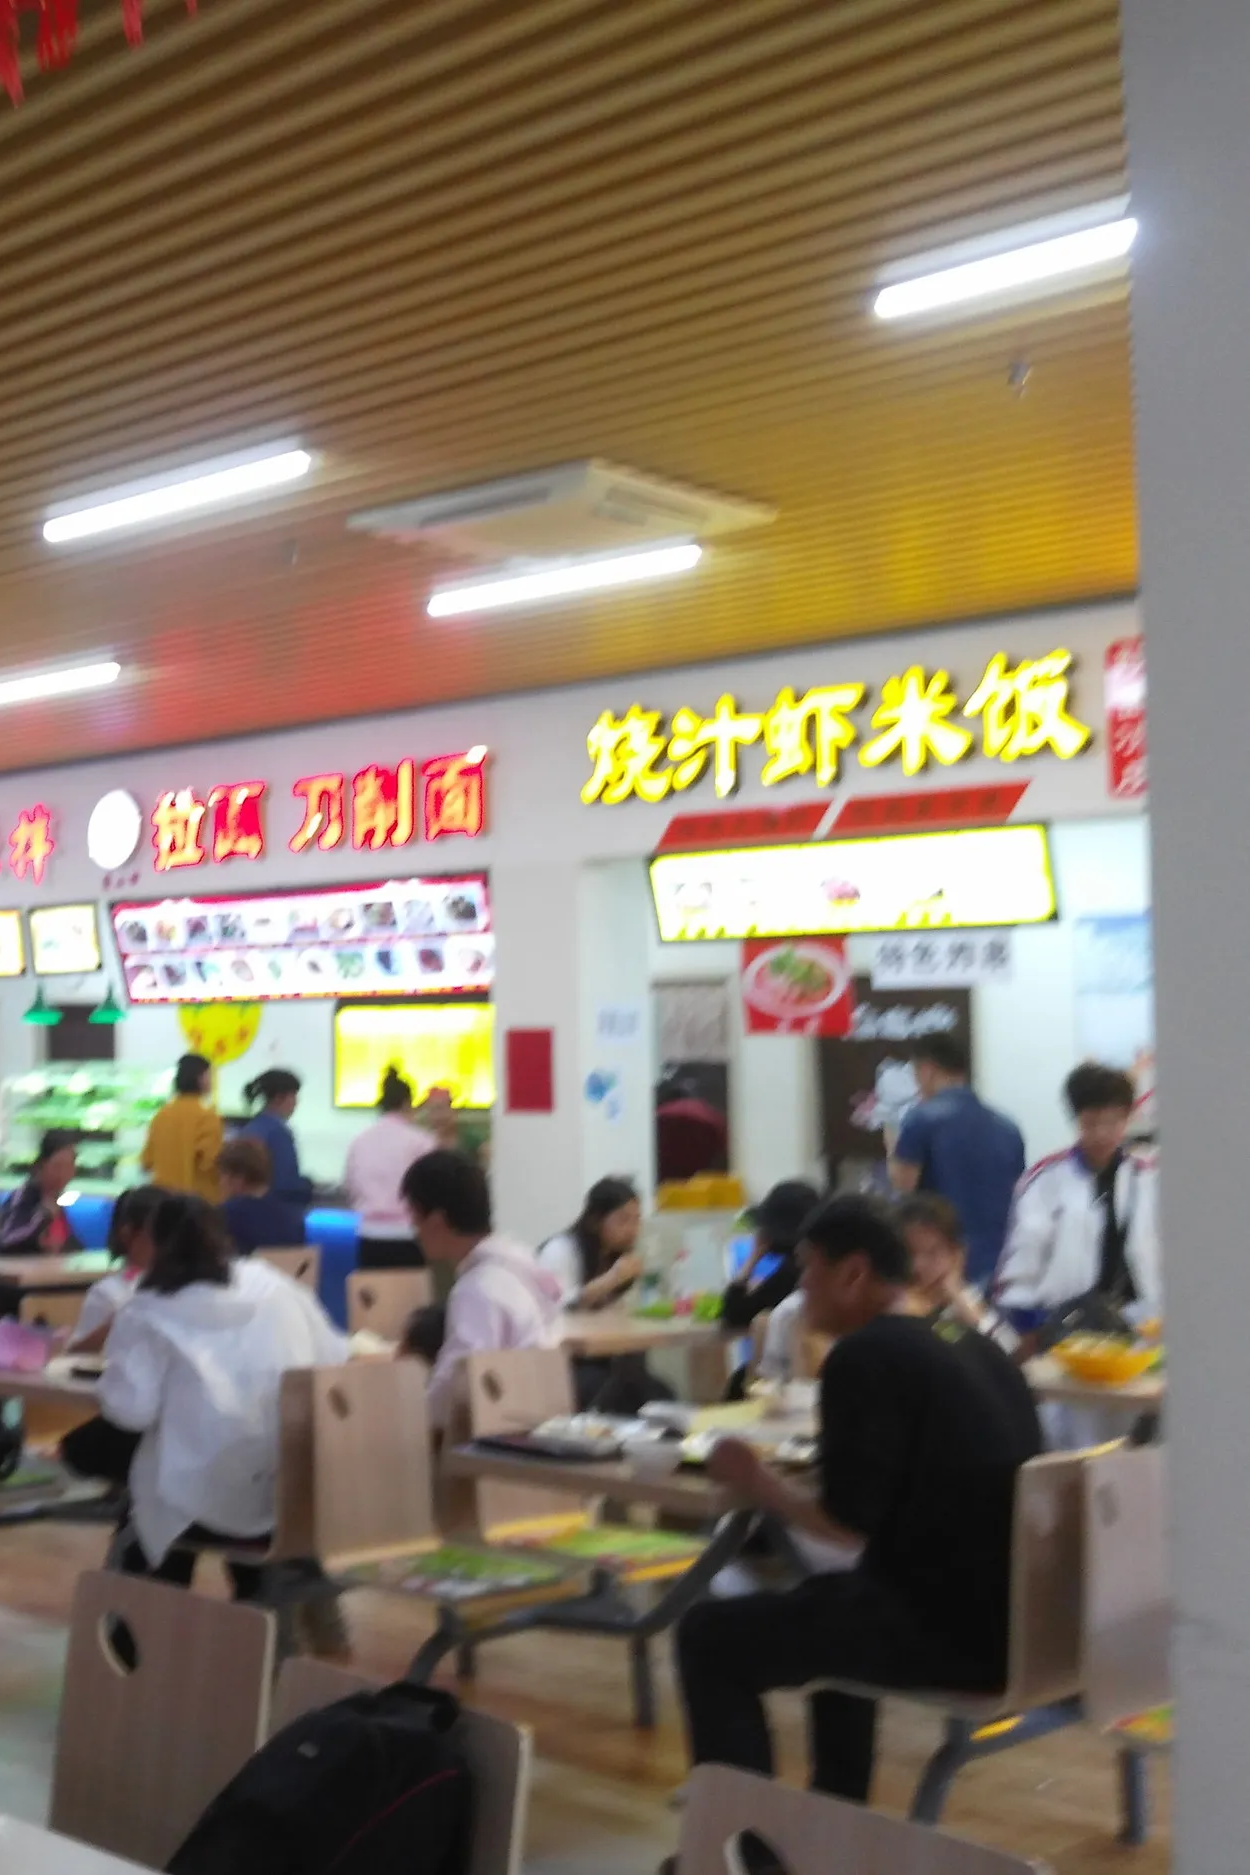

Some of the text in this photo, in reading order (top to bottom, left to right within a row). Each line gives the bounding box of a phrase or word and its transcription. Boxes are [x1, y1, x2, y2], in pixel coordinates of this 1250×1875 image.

[581, 648, 1090, 805] 烧汁虾米饭
[288, 745, 487, 853] 刀削面
